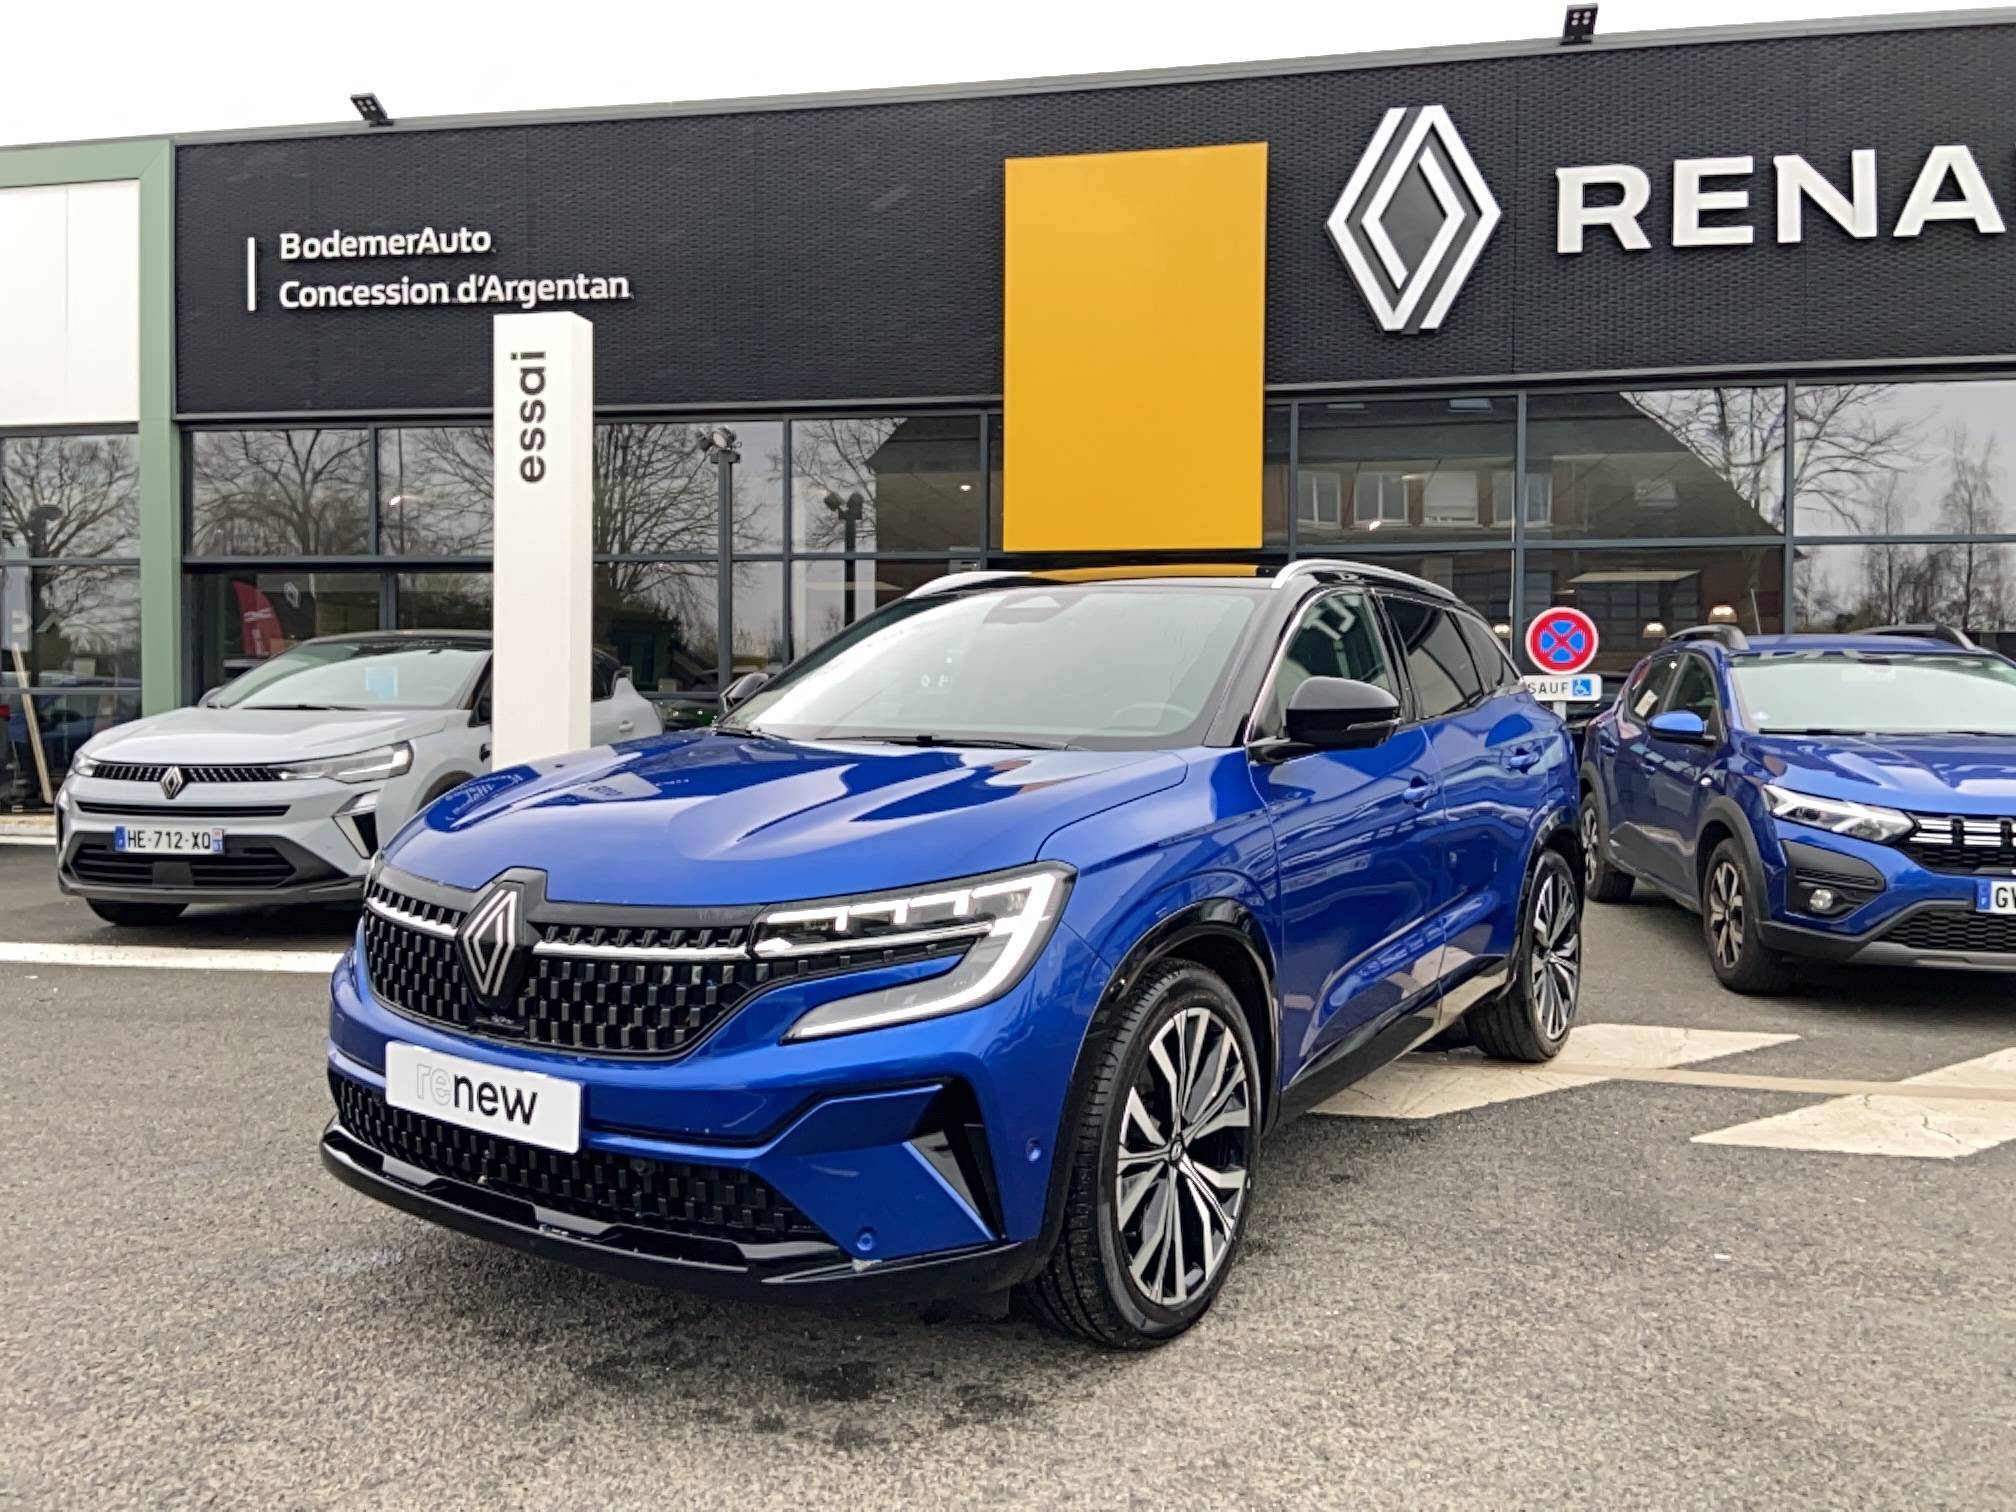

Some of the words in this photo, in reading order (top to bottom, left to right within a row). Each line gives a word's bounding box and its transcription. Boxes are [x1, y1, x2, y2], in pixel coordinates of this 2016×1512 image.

[1555, 144, 2007, 254] RENA
[279, 226, 492, 260] BodemerAuto
[279, 275, 450, 309] Concession
[456, 272, 631, 309] d'Argentan
[510, 350, 546, 484] essai
[1527, 681, 1569, 695] SAUF
[416, 1063, 538, 1126] renew
